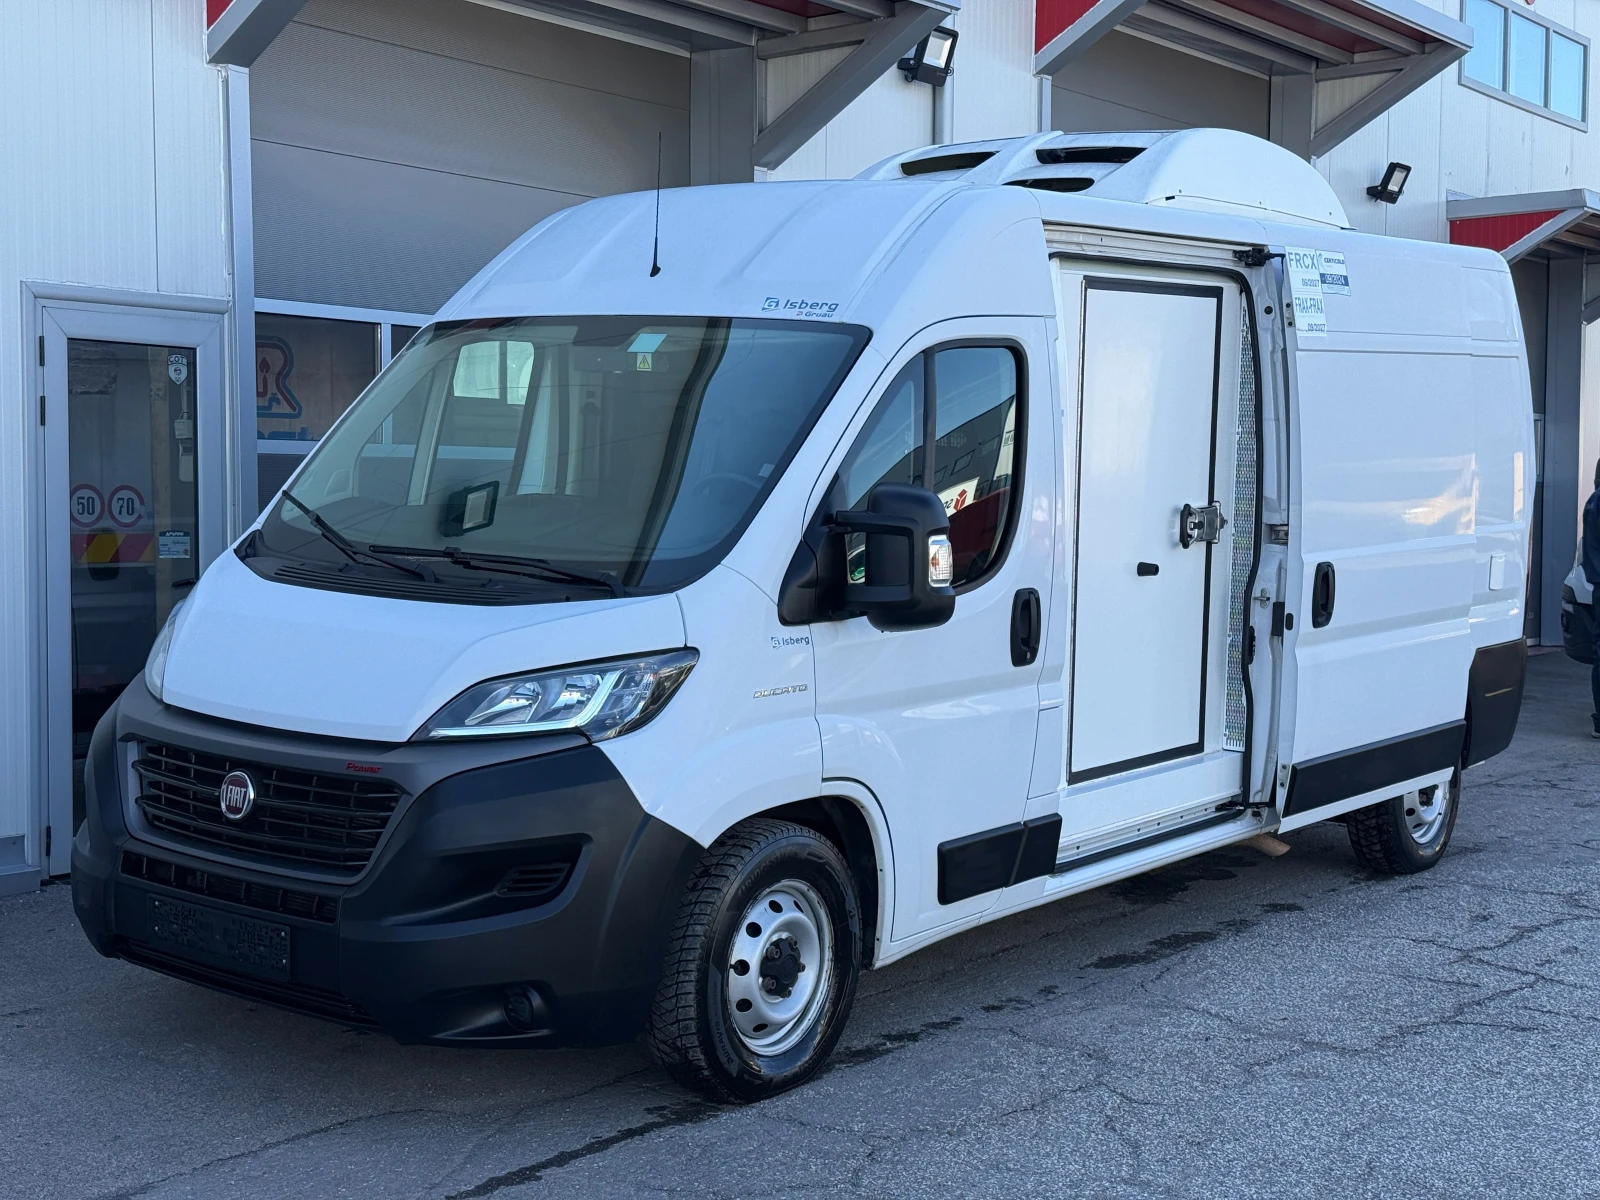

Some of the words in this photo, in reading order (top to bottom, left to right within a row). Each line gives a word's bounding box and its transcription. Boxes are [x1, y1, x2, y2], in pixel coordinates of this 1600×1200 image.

[1287, 252, 1318, 270] FRCX
[783, 299, 839, 313] Isberg
[76, 496, 96, 516] 50
[116, 497, 135, 516] 70
[782, 636, 810, 646] Isberg
[753, 684, 809, 699] DUCATO
[226, 785, 247, 809] FIAT
